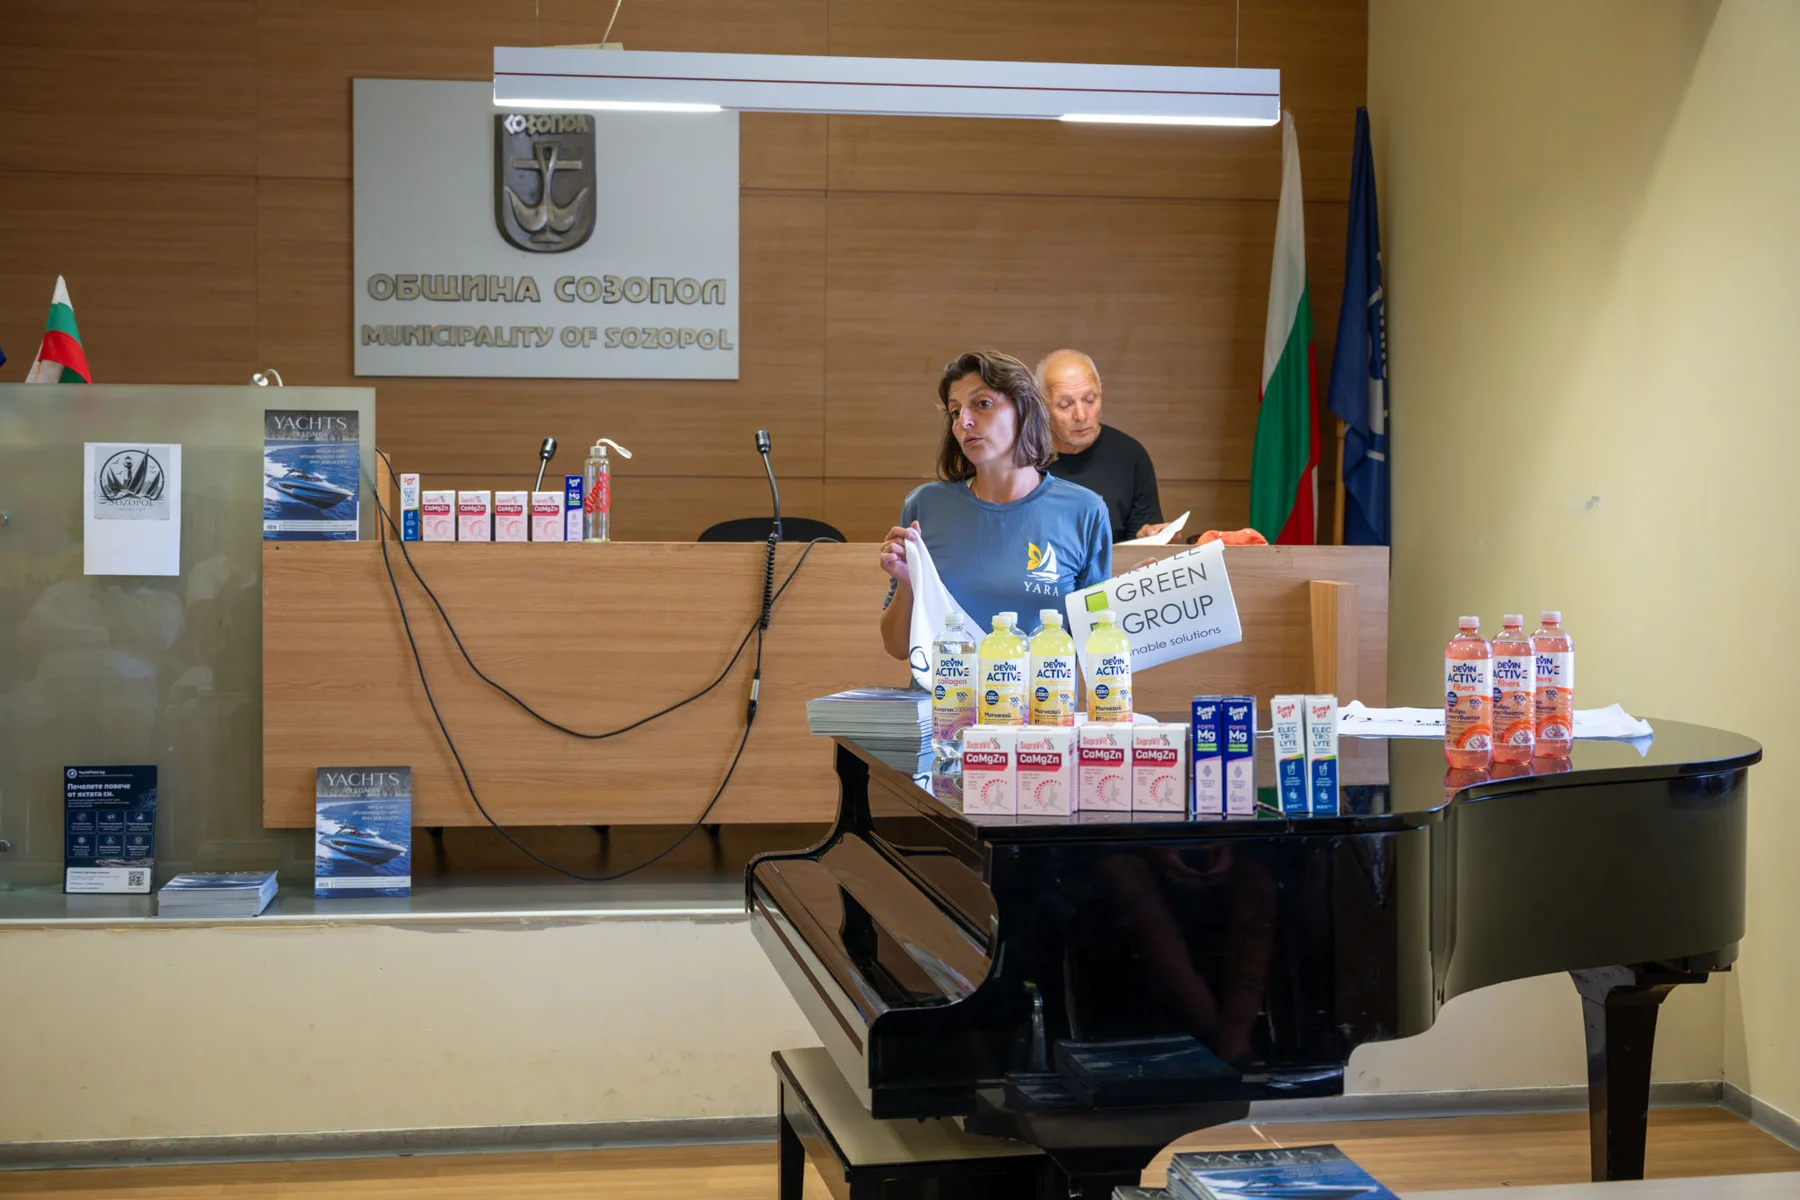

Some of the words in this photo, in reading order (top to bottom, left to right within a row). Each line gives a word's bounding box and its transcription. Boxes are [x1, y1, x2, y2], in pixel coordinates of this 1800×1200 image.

[367, 273, 541, 303] ОБЩИНА
[554, 274, 727, 305] СОЗОПОЛ
[361, 324, 553, 348] MUNICIPALITY
[560, 326, 597, 348] OF
[604, 327, 734, 350] SOZOPOL
[274, 416, 347, 430] YACHTS
[1115, 562, 1208, 602] GREEN
[1023, 581, 1060, 597] YARA
[1122, 594, 1214, 634] GROUP
[1130, 640, 1167, 657] inable
[1170, 626, 1222, 646] solutions
[941, 658, 963, 667] DEVIN
[1043, 660, 1067, 669] DEVIN
[1102, 657, 1124, 666] DEVIN
[1497, 660, 1521, 669] DEVIN
[1536, 657, 1553, 665] EVIN
[935, 668, 970, 677] ACTIVE
[994, 663, 1017, 672] DEVIN
[1096, 665, 1129, 676] ACTIVE
[1453, 664, 1477, 673] DEVIN
[1536, 665, 1560, 675] TIVE
[986, 672, 1022, 682] ACTIVE
[1036, 669, 1072, 679] ACTIVE
[1447, 673, 1483, 683] ACTIVE
[1493, 669, 1527, 679] ACTIVE
[937, 677, 967, 686] collagen
[1497, 679, 1520, 688] fibers
[1453, 683, 1476, 691] fibers
[1197, 730, 1216, 742] Mg
[1229, 730, 1247, 743] Mg
[966, 753, 1006, 765] CaMgZn
[1019, 753, 1060, 765] CaMgZn
[1082, 749, 1122, 761] CaMgZn
[1135, 749, 1175, 761] CaMgZn
[326, 772, 400, 786] YACHTS
